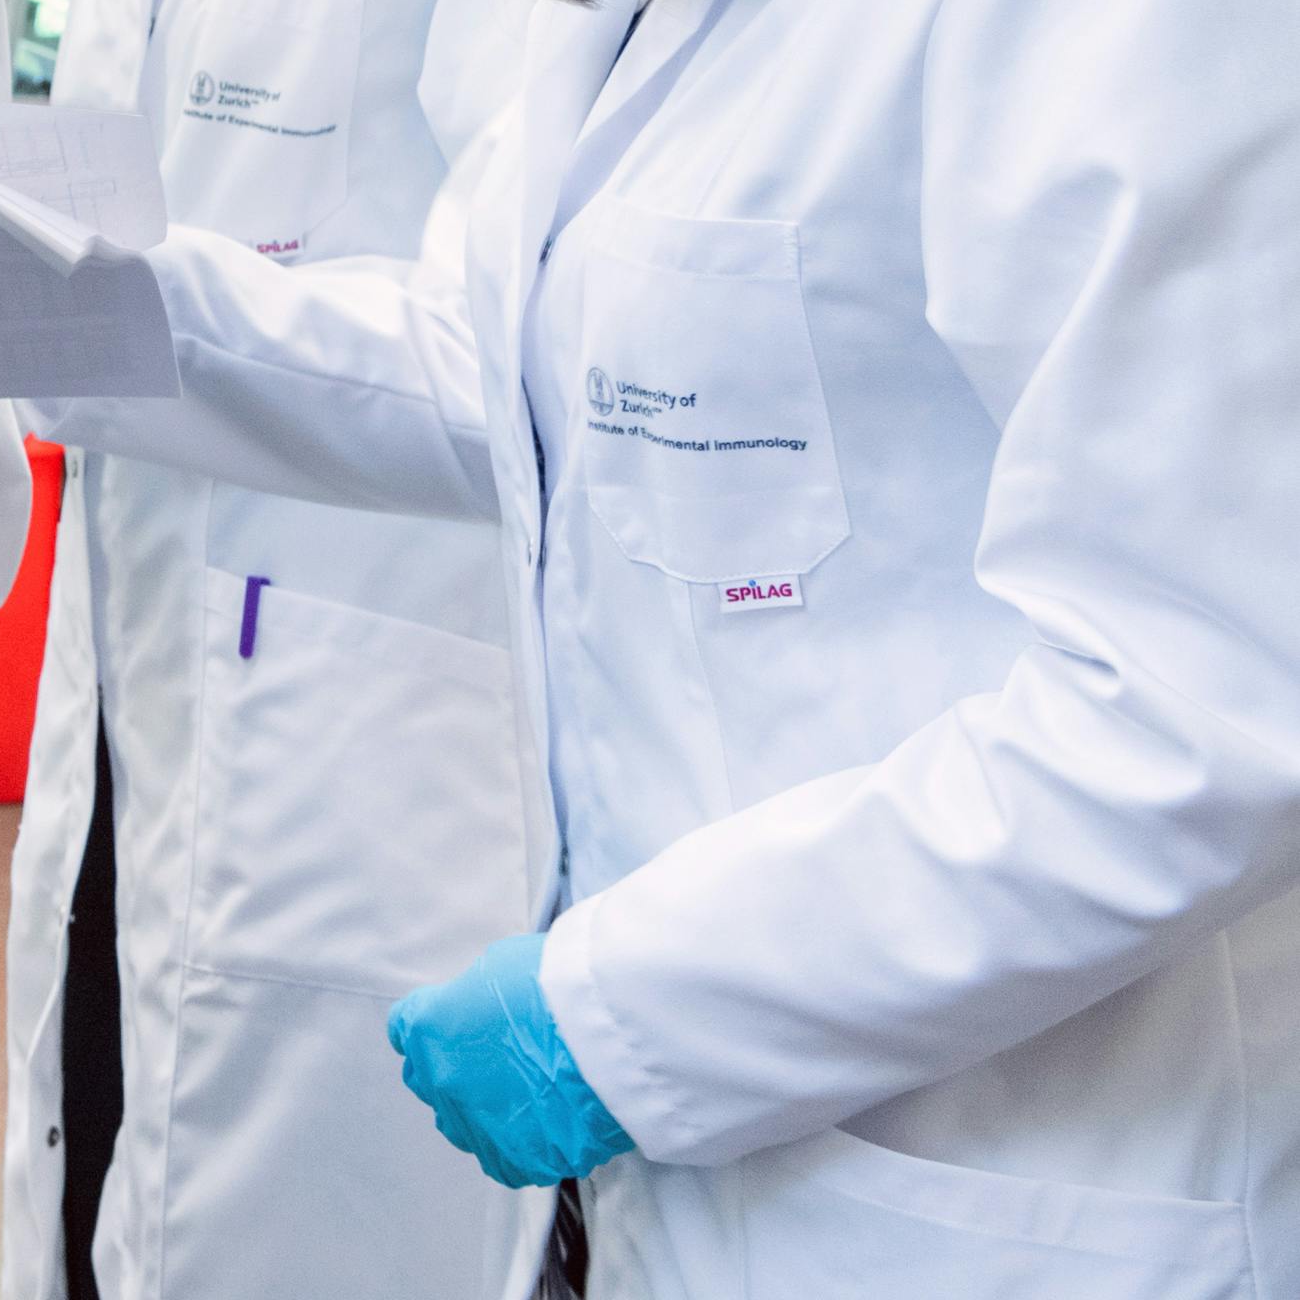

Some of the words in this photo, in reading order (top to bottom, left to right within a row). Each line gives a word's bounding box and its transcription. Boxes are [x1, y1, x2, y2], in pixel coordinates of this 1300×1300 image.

[219, 81, 270, 102] University
[218, 94, 251, 110] Zurich
[215, 113, 227, 123] of
[616, 380, 677, 409] University
[678, 392, 697, 409] of
[619, 399, 654, 419] Zurich
[587, 419, 626, 437] Institute
[628, 426, 639, 438] of
[714, 437, 808, 453] Immunology
